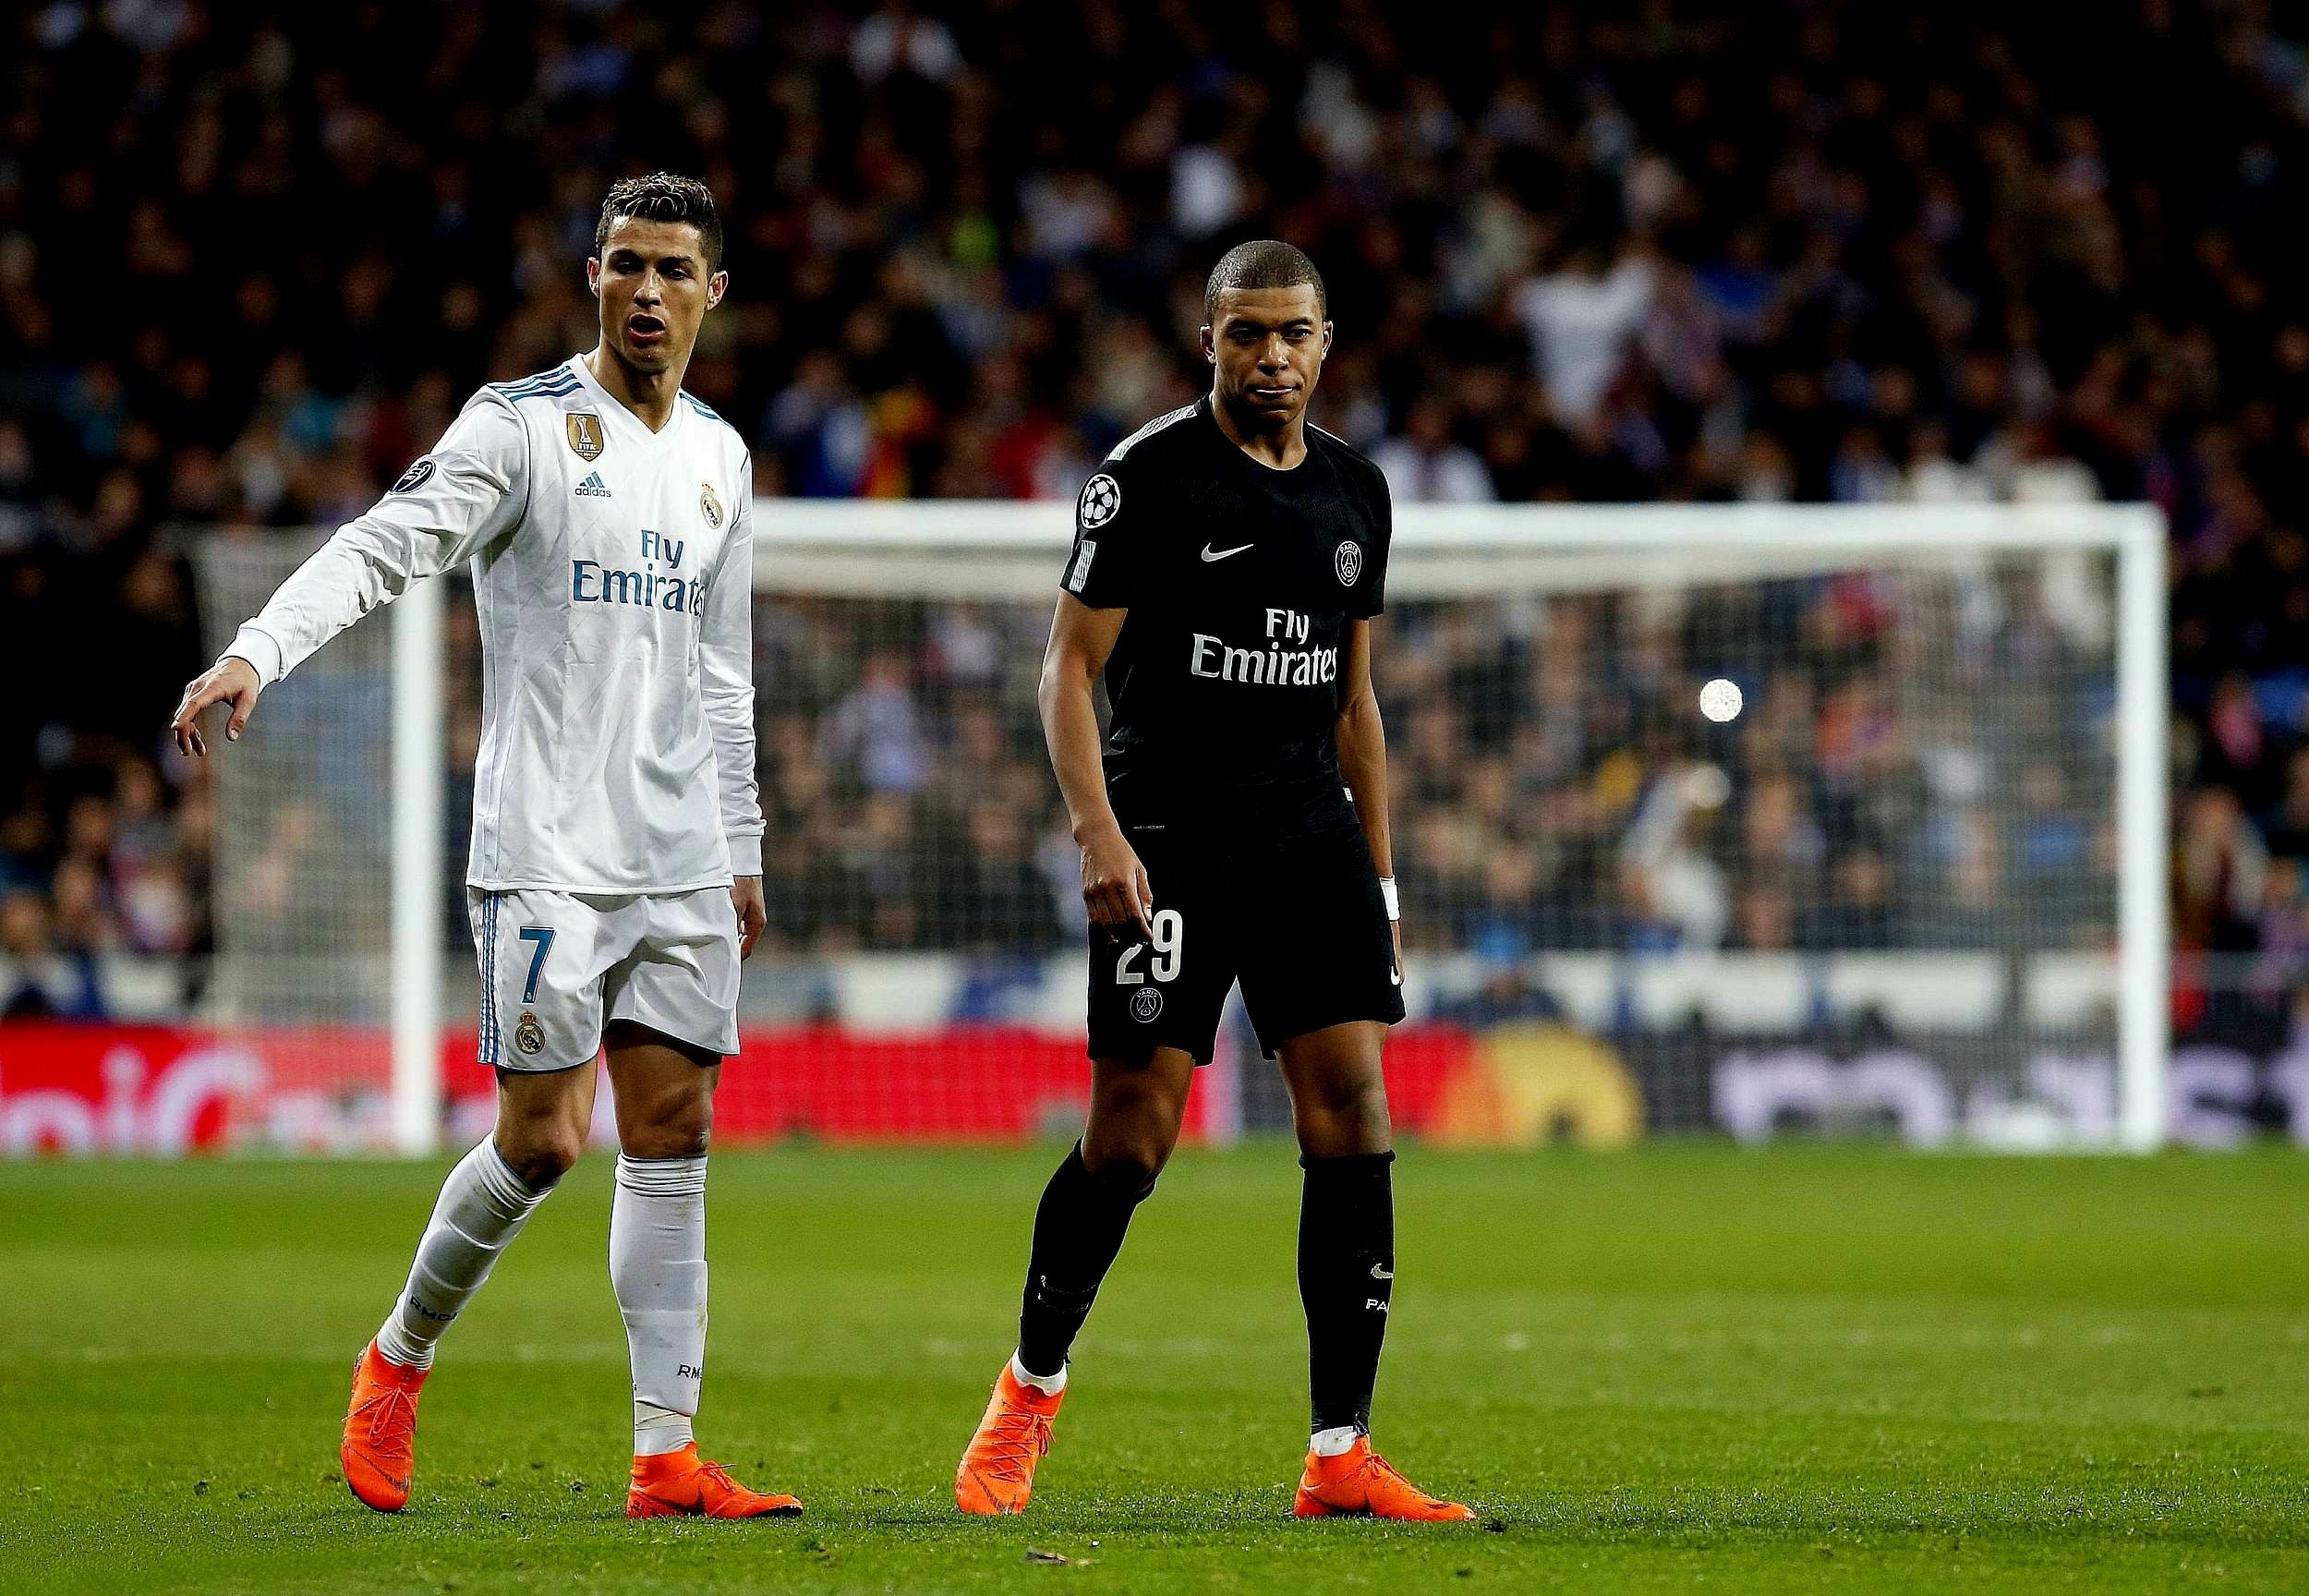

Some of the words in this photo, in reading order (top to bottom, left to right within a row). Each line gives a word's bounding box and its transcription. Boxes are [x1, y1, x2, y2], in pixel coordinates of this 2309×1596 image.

[574, 486, 611, 498] adidas
[641, 529, 683, 569] Fly
[1265, 608, 1310, 645] Fly
[519, 925, 558, 1005] 7
[1116, 909, 1183, 985] 29
[676, 1363, 702, 1380] RM
